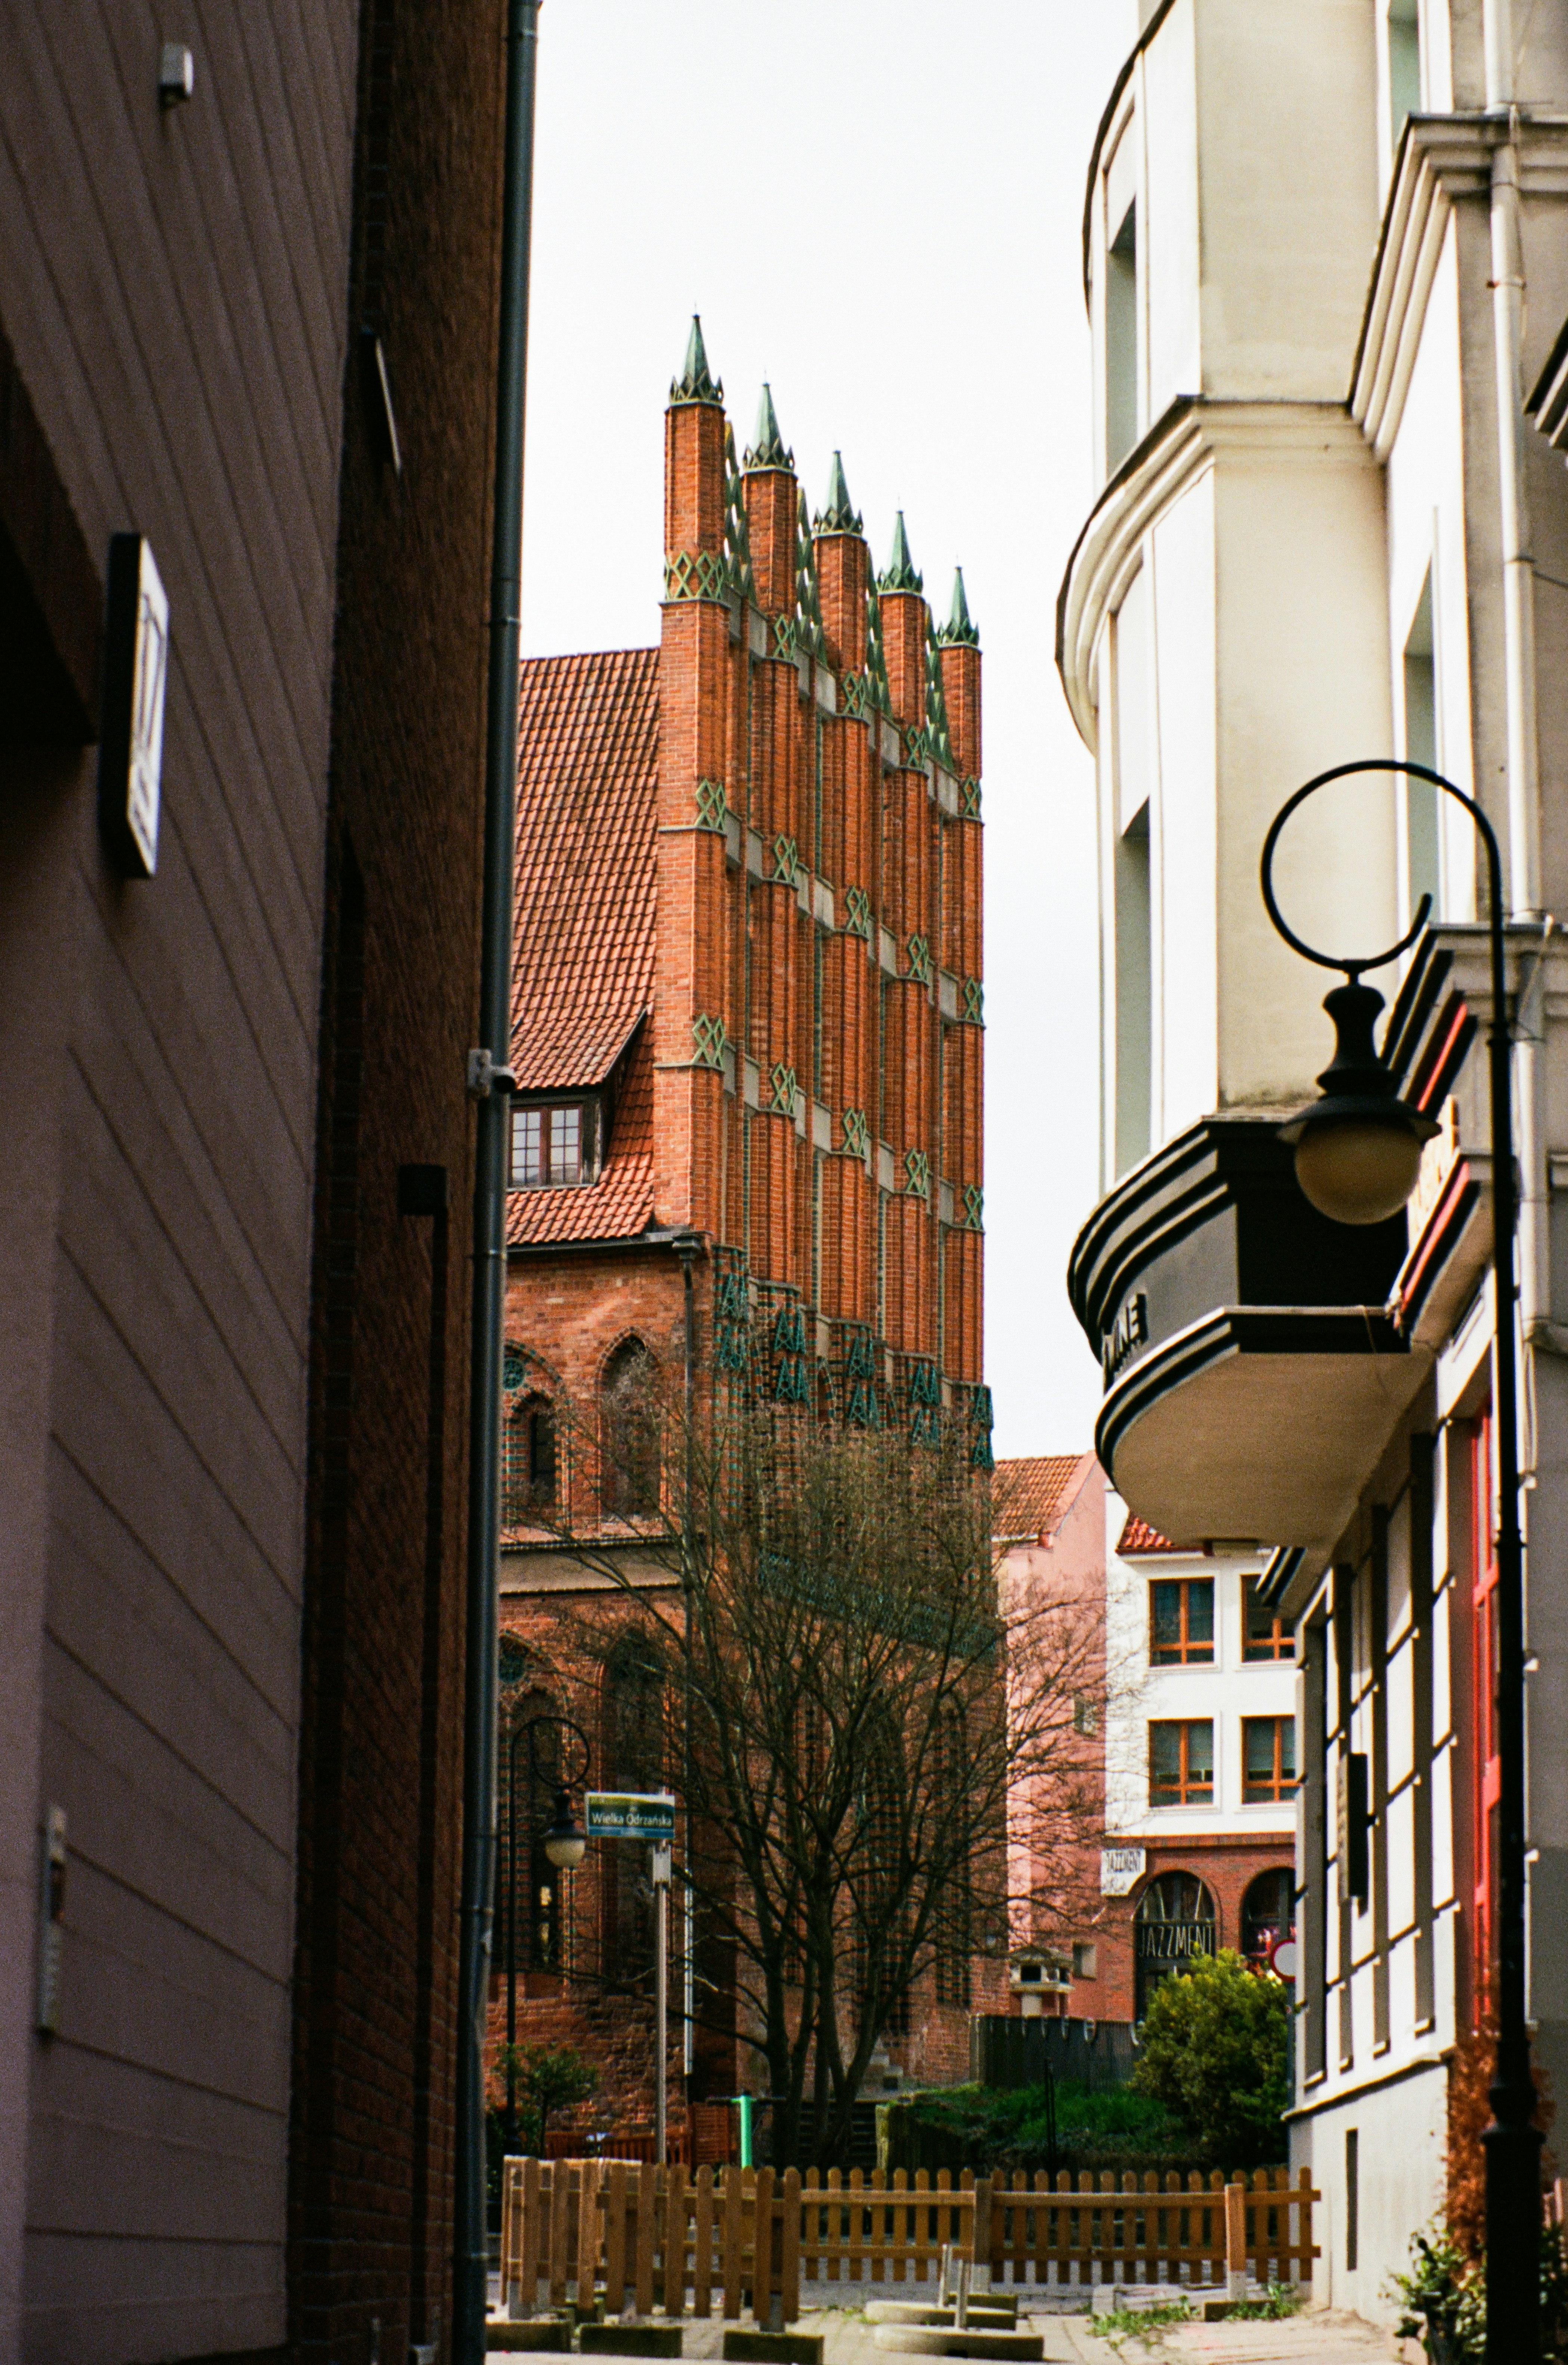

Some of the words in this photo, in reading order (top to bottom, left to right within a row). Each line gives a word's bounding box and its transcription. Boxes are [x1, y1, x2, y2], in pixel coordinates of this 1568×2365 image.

[591, 1812, 624, 1826] Wielka
[626, 1813, 672, 1827] Odrzańska
[1139, 1925, 1212, 1957] JAZZMENT
